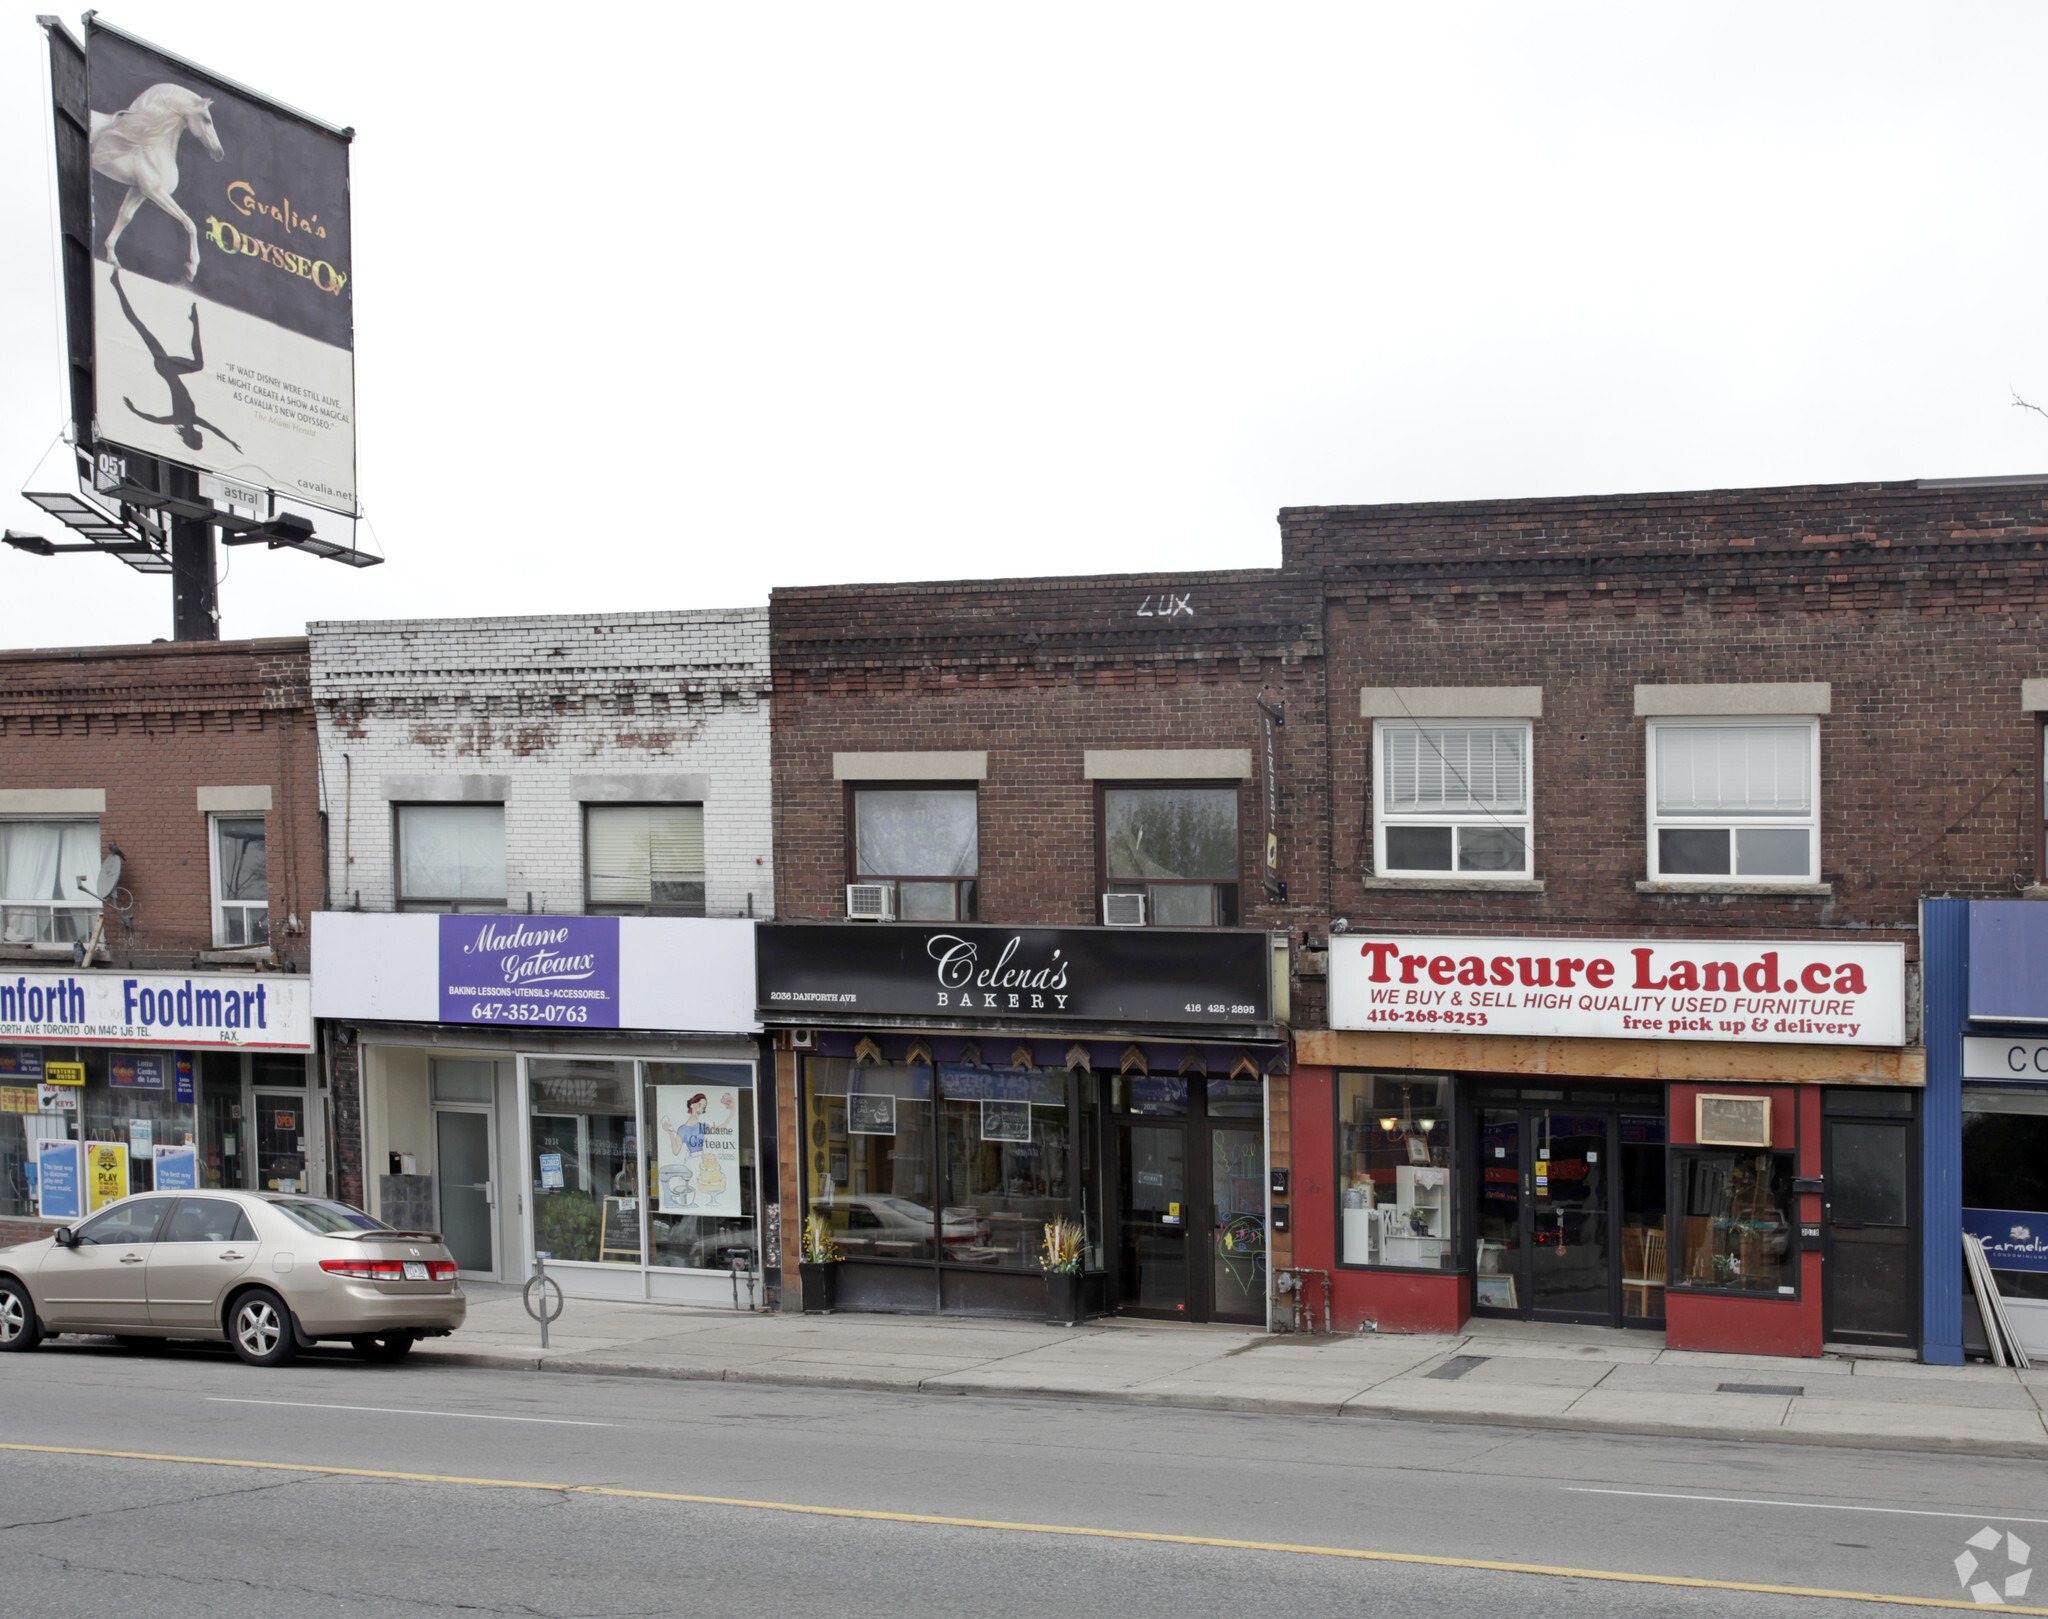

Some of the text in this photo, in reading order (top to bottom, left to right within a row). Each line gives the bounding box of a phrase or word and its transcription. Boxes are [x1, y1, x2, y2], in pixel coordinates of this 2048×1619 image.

[227, 181, 327, 239] Cavalia's
[206, 216, 347, 296] ODYSSEO
[237, 366, 255, 378] WALT
[257, 372, 281, 388] DISNEY
[283, 382, 302, 396] WERE
[303, 389, 320, 402] STILL
[216, 372, 350, 424] HE MIGHT CREATE A SHOW AS MAGICAL
[233, 391, 243, 402] AS
[244, 395, 279, 414] CAVALIA'S
[280, 407, 296, 419] NEW
[254, 410, 267, 420] The
[100, 453, 128, 478] 051
[224, 486, 259, 505] astral
[298, 479, 353, 502] cavalia.net
[1137, 592, 1194, 617] LUX
[464, 923, 569, 954] Madame
[501, 949, 596, 985] Gateaux
[927, 934, 1068, 989] Celena's
[1361, 942, 1867, 995] Treasure Land.ca
[449, 986, 477, 996] BAKING
[770, 991, 857, 1002] 2036 DANFORTH AVE
[937, 992, 1069, 1009] BAKERY
[123, 979, 267, 1029] Foodmart
[1184, 1003, 1202, 1012] 416
[1370, 989, 1856, 1016] WE BUY & SELL HIGH QUALITY USED FURNITURE
[471, 1003, 588, 1022] 647-352-0763
[1367, 1008, 1489, 1026] 416-268-8253
[24, 1025, 40, 1034] AVE
[43, 1024, 80, 1035] TORONTO
[84, 1026, 96, 1035] ON
[98, 1026, 117, 1036] M4C
[120, 1027, 133, 1037] 1J6
[137, 1026, 152, 1037] TEL.
[1623, 1015, 1861, 1037] free pick up & delivery
[220, 1031, 239, 1041] FAX.
[276, 1115, 294, 1127] OPEN
[698, 1122, 733, 1135] Madame
[688, 1135, 736, 1150] Gateaux
[43, 1163, 52, 1171] The
[53, 1163, 63, 1171] best
[98, 1172, 117, 1182] PLAY
[1992, 1252, 2047, 1260] CONDOMINIUMS
